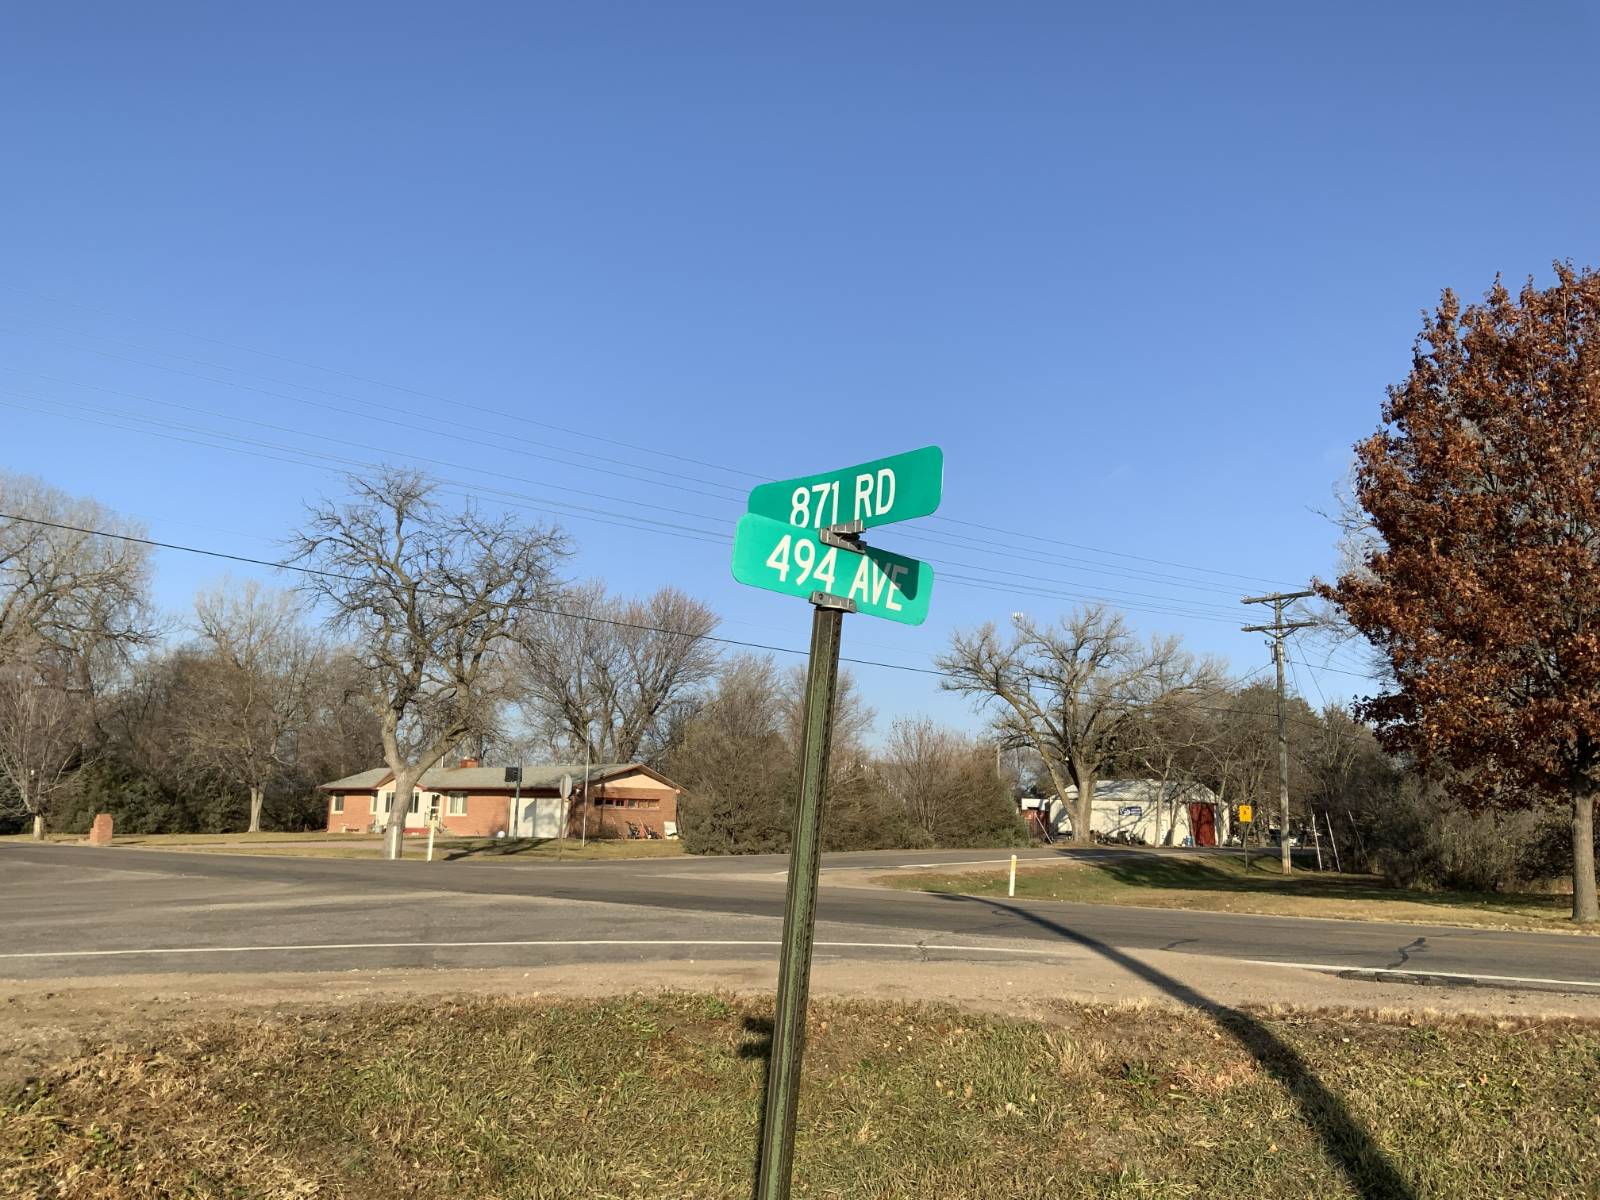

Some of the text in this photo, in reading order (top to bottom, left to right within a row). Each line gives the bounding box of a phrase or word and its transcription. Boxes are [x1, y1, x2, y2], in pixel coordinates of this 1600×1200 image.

[790, 468, 896, 528] 871 RD
[766, 534, 909, 611] 494 AVE
